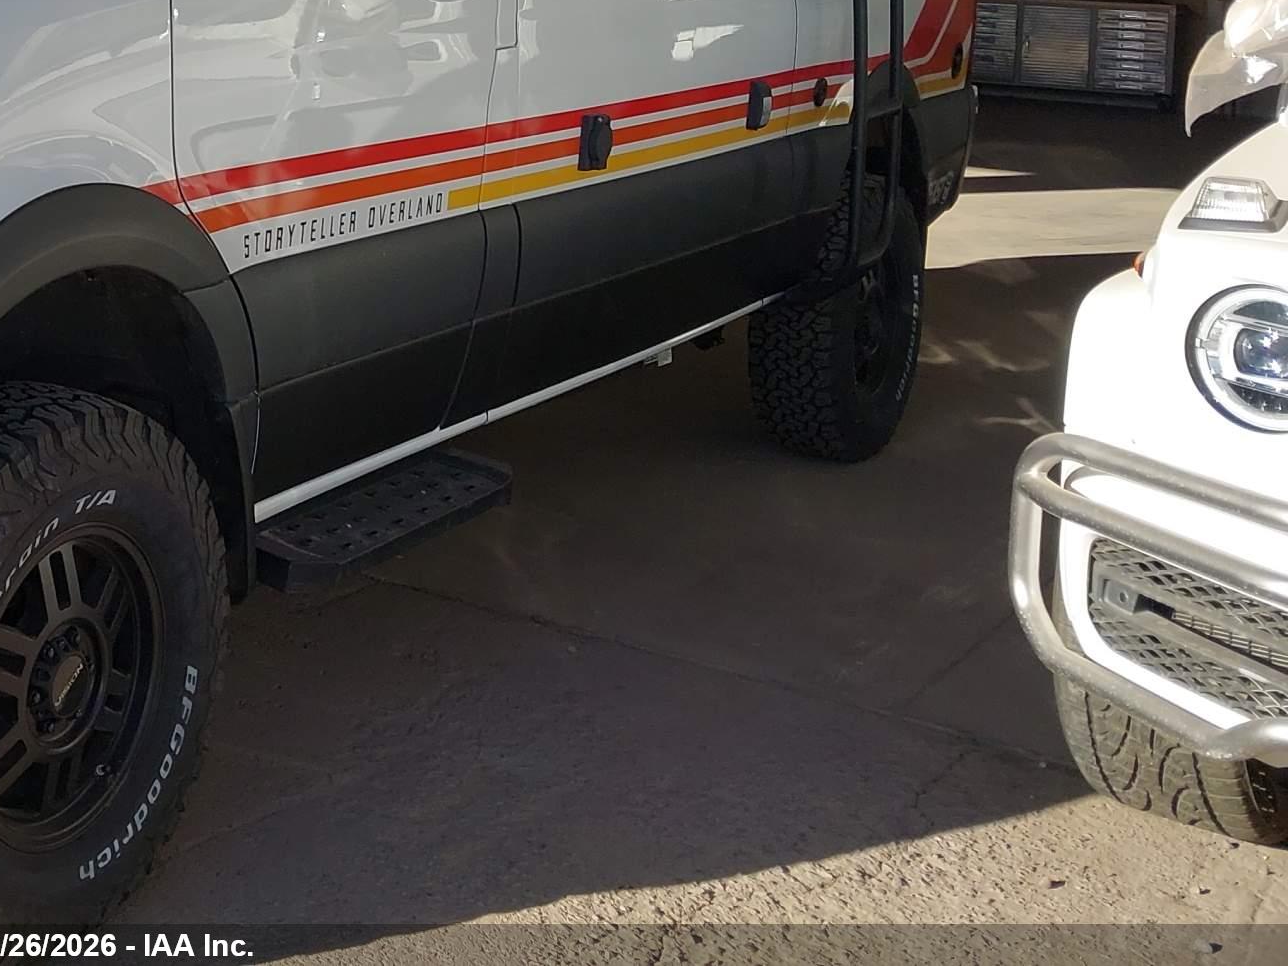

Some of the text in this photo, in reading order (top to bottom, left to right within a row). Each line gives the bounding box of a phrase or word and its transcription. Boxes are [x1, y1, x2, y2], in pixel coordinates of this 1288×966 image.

[243, 192, 444, 259] STORYTELLER OVERLAND
[74, 489, 117, 515] T/A
[79, 664, 199, 881] BFGoodrich
